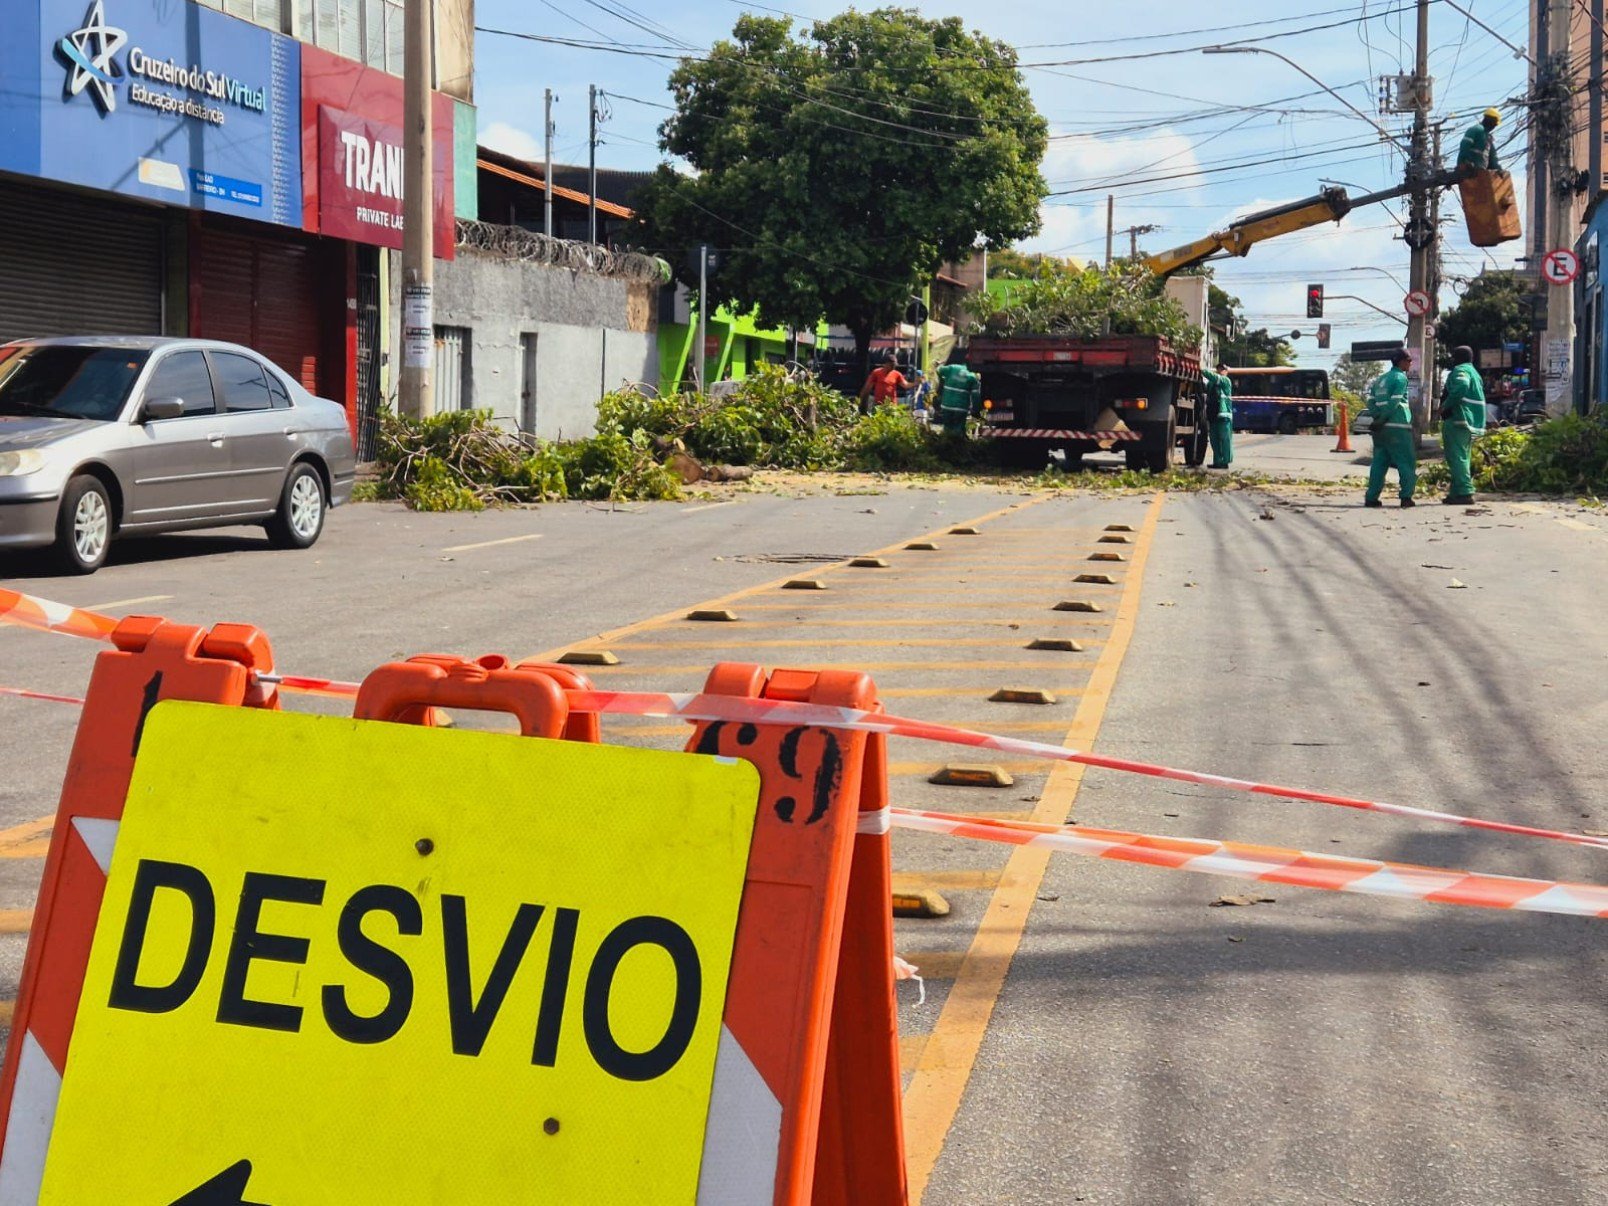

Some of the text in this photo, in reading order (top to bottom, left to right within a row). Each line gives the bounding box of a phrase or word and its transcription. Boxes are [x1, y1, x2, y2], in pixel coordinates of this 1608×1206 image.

[130, 47, 267, 112] Cruzeiro do Sul Virtual
[132, 83, 178, 112] Educação
[179, 101, 185, 114] a
[356, 206, 390, 228] PRIVATE
[1553, 256, 1568, 277] E
[107, 858, 702, 1082] DESVIO
